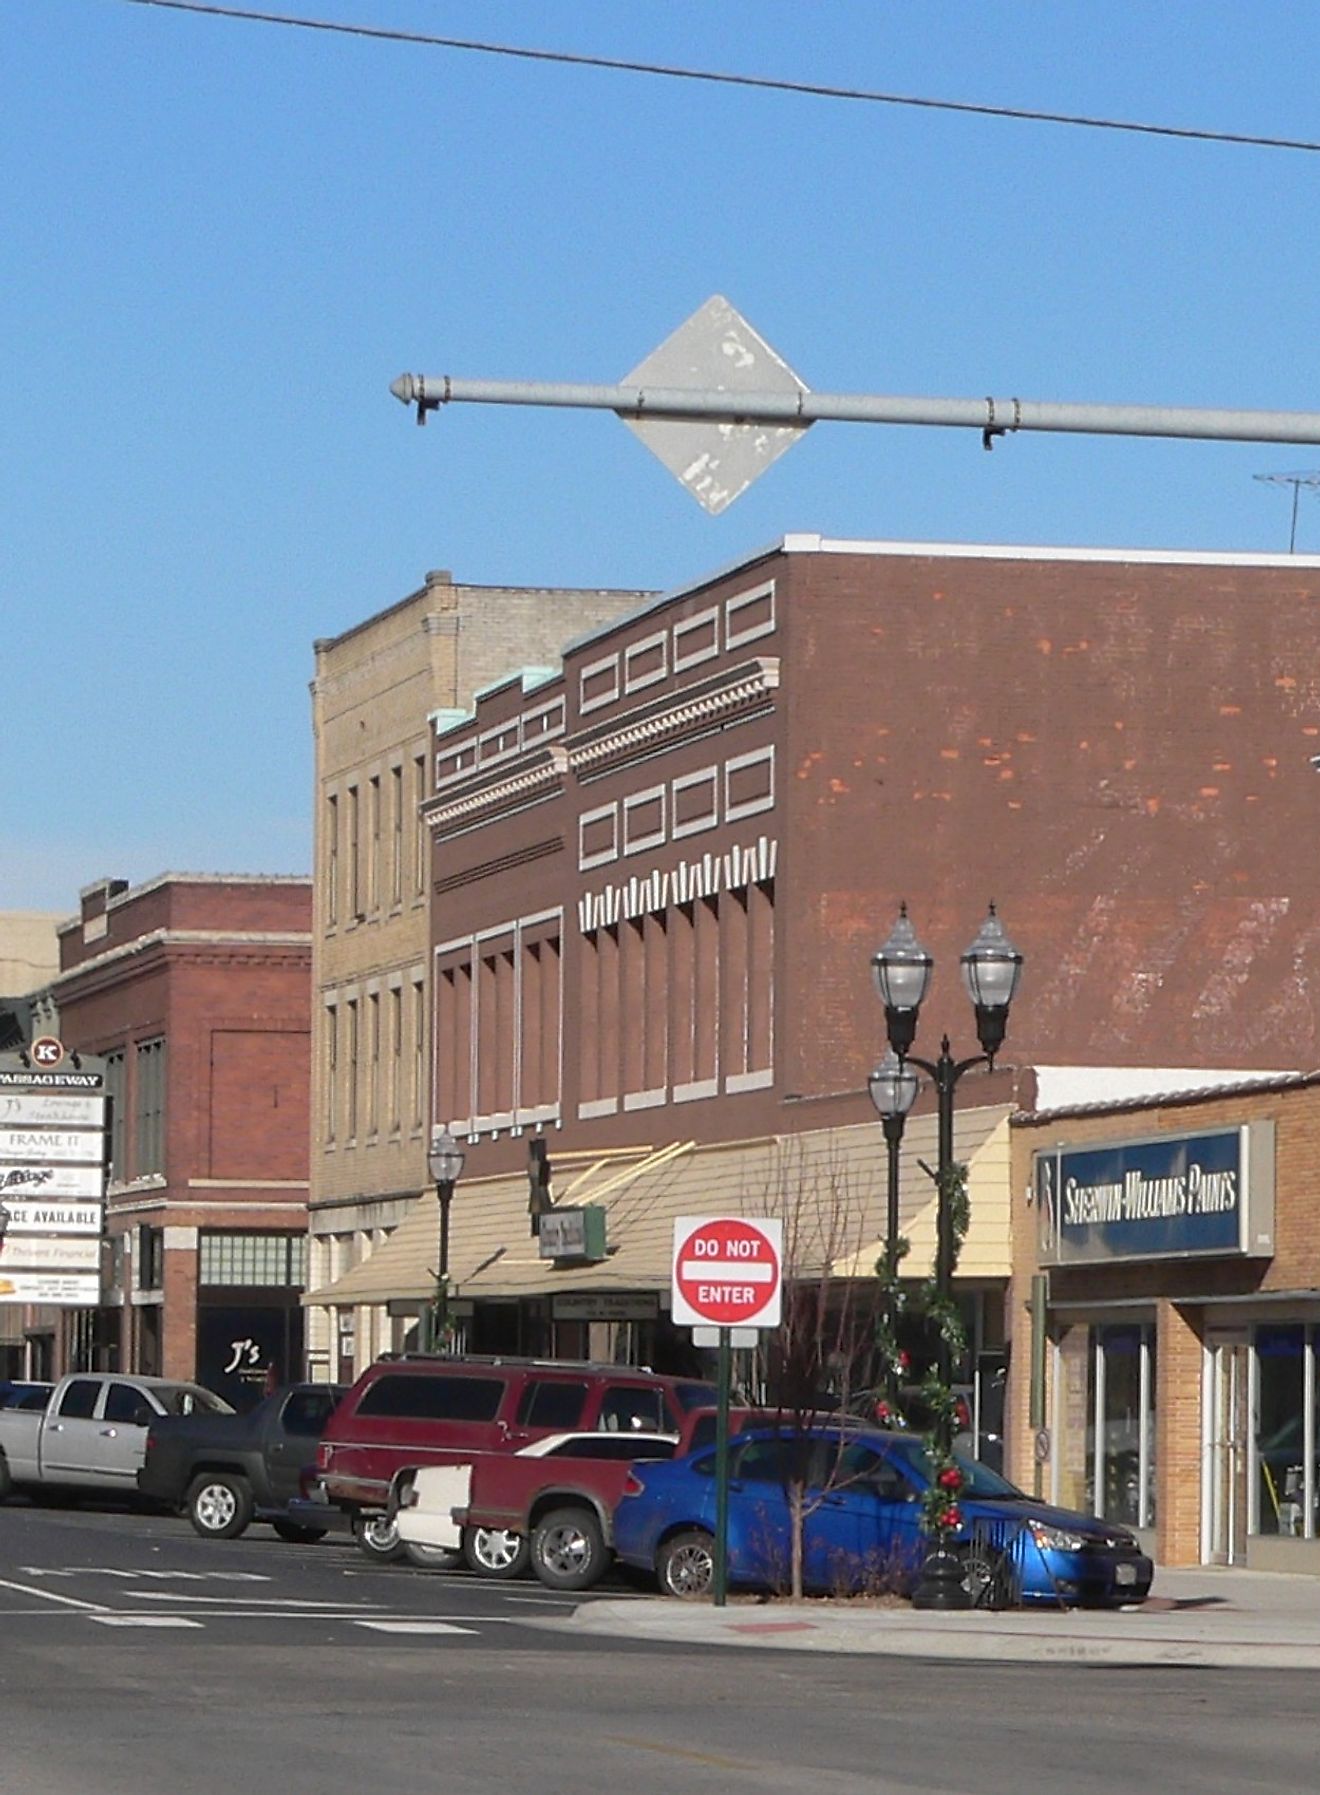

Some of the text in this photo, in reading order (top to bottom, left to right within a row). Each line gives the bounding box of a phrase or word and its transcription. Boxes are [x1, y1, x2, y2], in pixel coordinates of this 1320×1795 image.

[37, 1045, 57, 1060] K
[9, 1134, 80, 1147] FRAME IT
[33, 1210, 96, 1224] AVAILABLE
[694, 1239, 760, 1258] DO NOT
[698, 1286, 756, 1304] ENTER
[224, 1338, 260, 1373] J's
